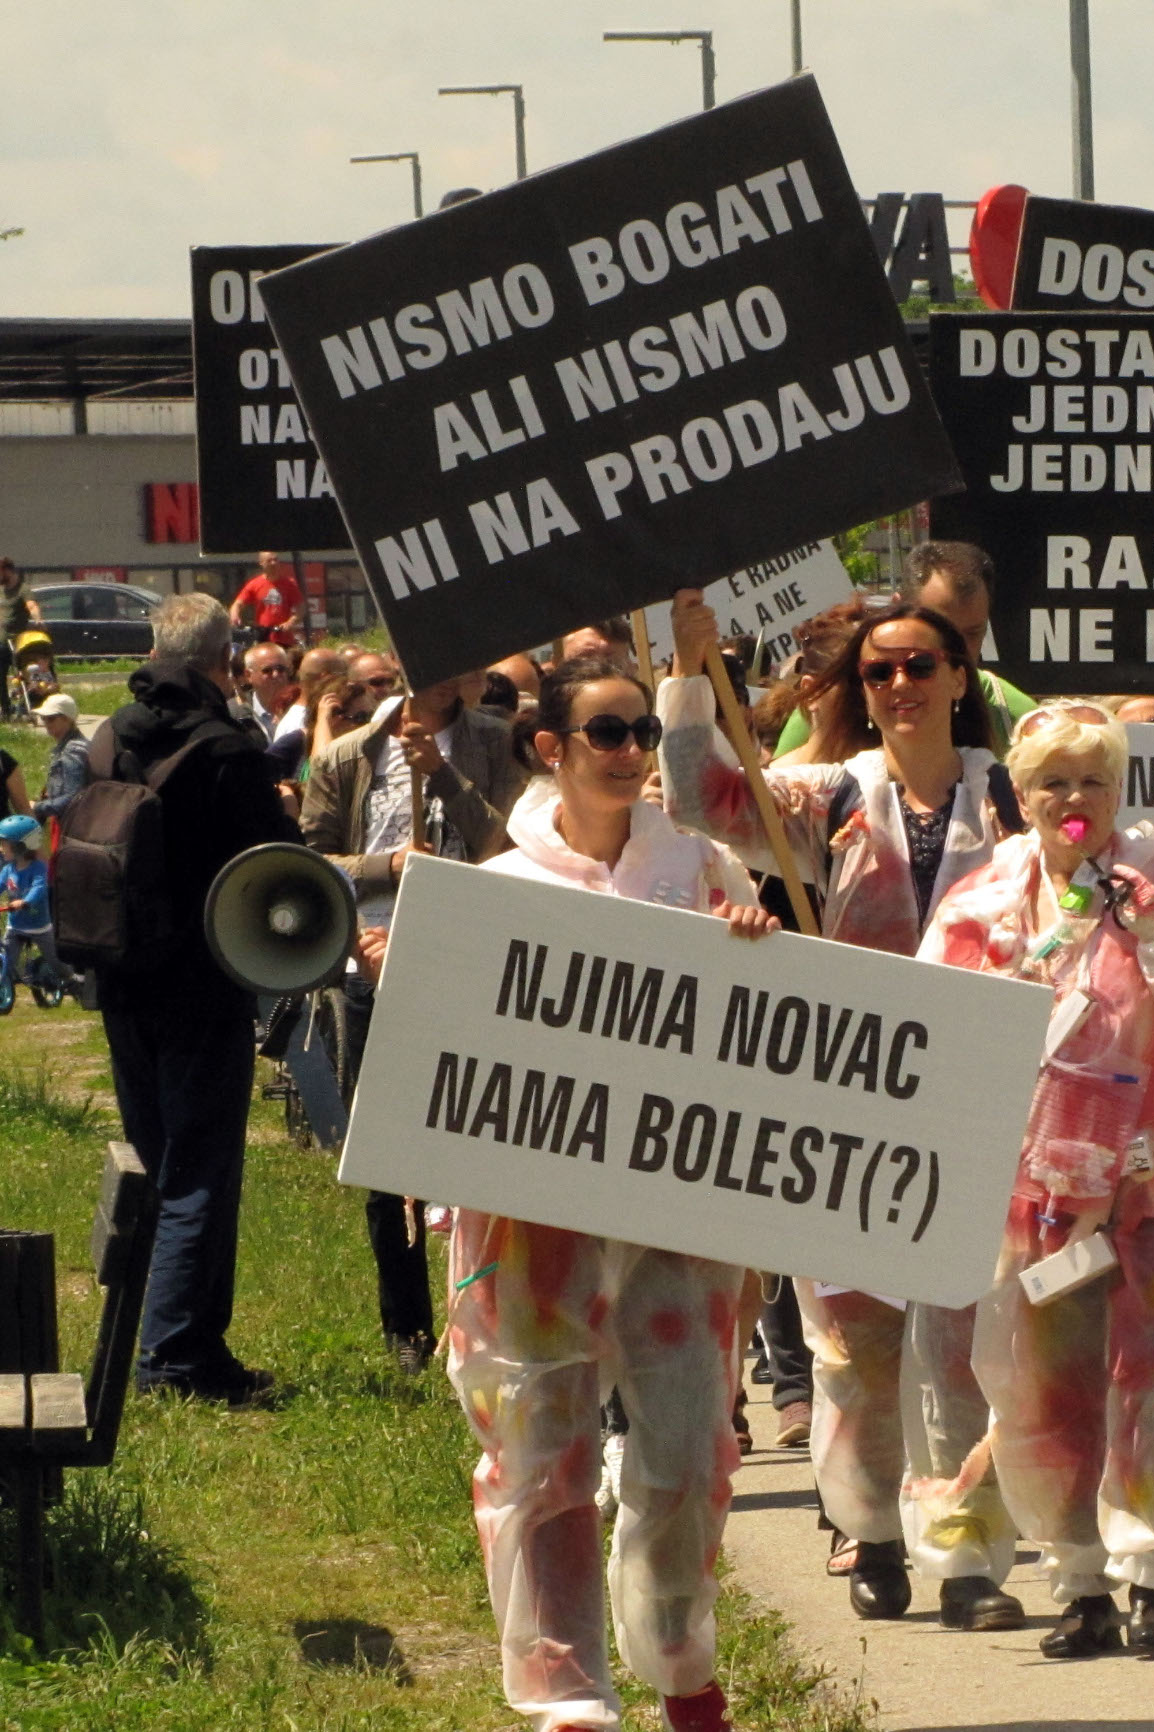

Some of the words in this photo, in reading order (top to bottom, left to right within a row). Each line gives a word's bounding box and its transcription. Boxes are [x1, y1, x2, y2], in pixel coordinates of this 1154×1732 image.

[320, 262, 554, 399] NISMO
[569, 160, 823, 306] BOGATI
[433, 375, 545, 472] ALI
[555, 285, 786, 422] NISMO
[374, 521, 461, 599] NI
[468, 478, 580, 565] NA
[586, 347, 911, 520] PRODAJU
[773, 582, 808, 616] NE
[1030, 609, 1114, 662] NE
[495, 938, 698, 1056] NJIMA
[717, 984, 928, 1101] NOVAC
[425, 1052, 609, 1164] NAMA
[628, 1093, 940, 1243] BOLEST(?)
